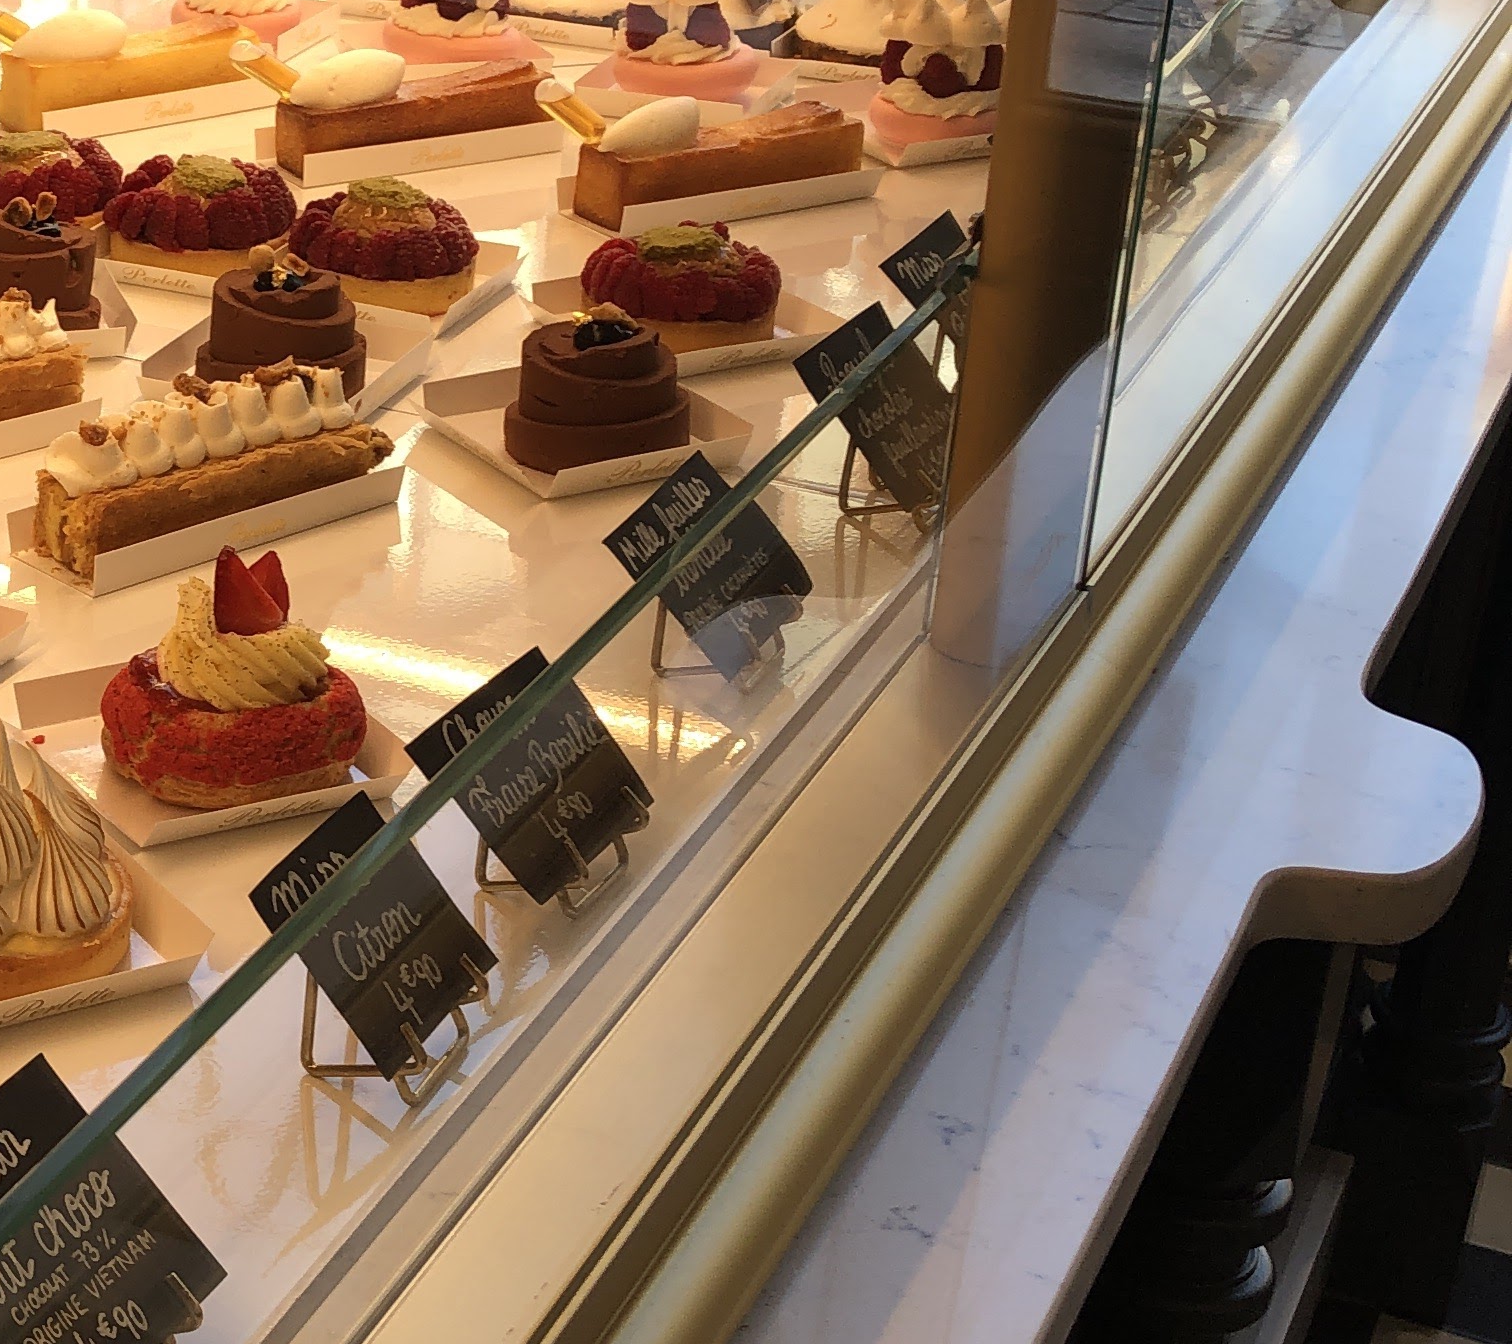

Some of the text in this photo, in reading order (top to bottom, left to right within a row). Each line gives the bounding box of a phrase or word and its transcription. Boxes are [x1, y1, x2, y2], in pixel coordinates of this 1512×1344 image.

[121, 266, 197, 291] Perlette
[218, 799, 324, 829] Perlette
[331, 899, 423, 982] Citron
[382, 952, 444, 1026] 4€90
[33, 1168, 118, 1258] choco
[10, 1262, 72, 1327] CHOCOLAT
[87, 1229, 157, 1299] VIETNAM
